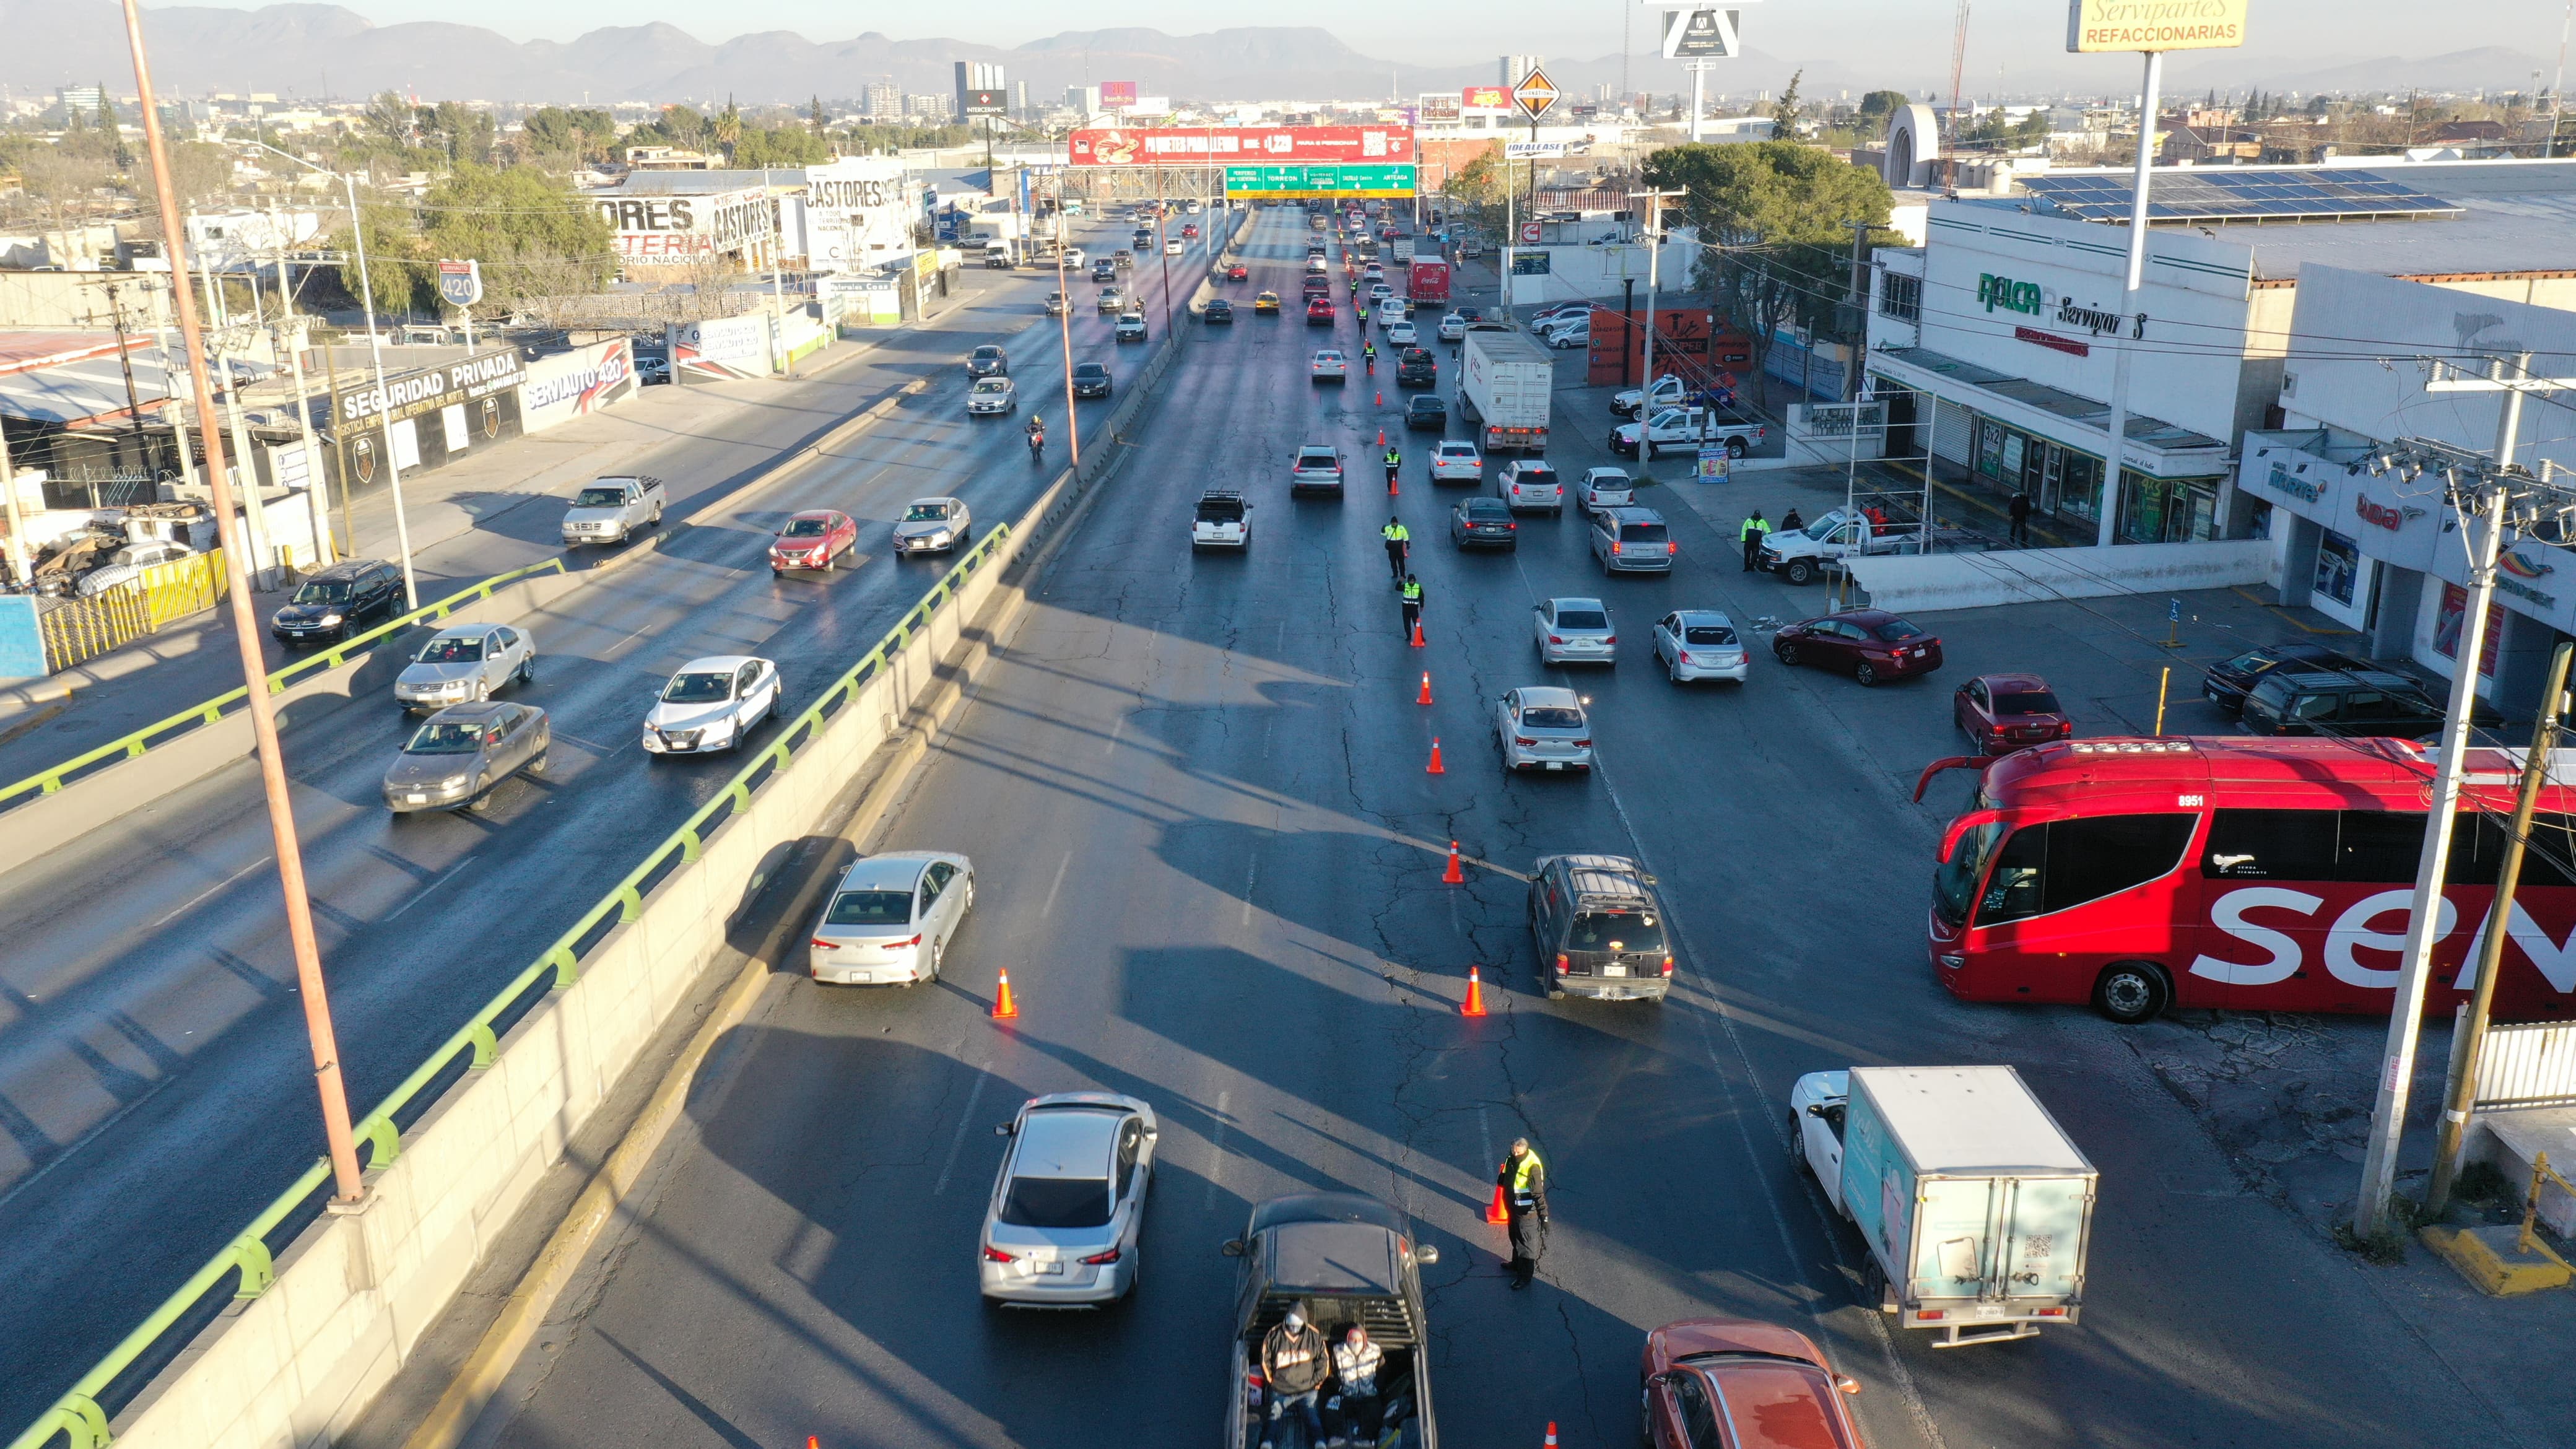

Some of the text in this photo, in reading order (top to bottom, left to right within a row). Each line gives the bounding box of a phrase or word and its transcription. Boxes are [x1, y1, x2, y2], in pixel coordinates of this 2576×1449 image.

[2086, 24, 2237, 43] REFACCIONARIAS
[806, 180, 882, 208] CASTORES
[594, 199, 693, 230] ORES
[714, 199, 768, 244] CASTORES
[443, 279, 473, 297] 420
[344, 353, 516, 419] SEGURIDAD PRIVADA
[527, 359, 623, 410] SERVIAUTO 420
[405, 399, 435, 417] OPERATIVA
[435, 396, 446, 409] DEL
[447, 389, 464, 404] NORTE
[2178, 795, 2203, 807] 8951
